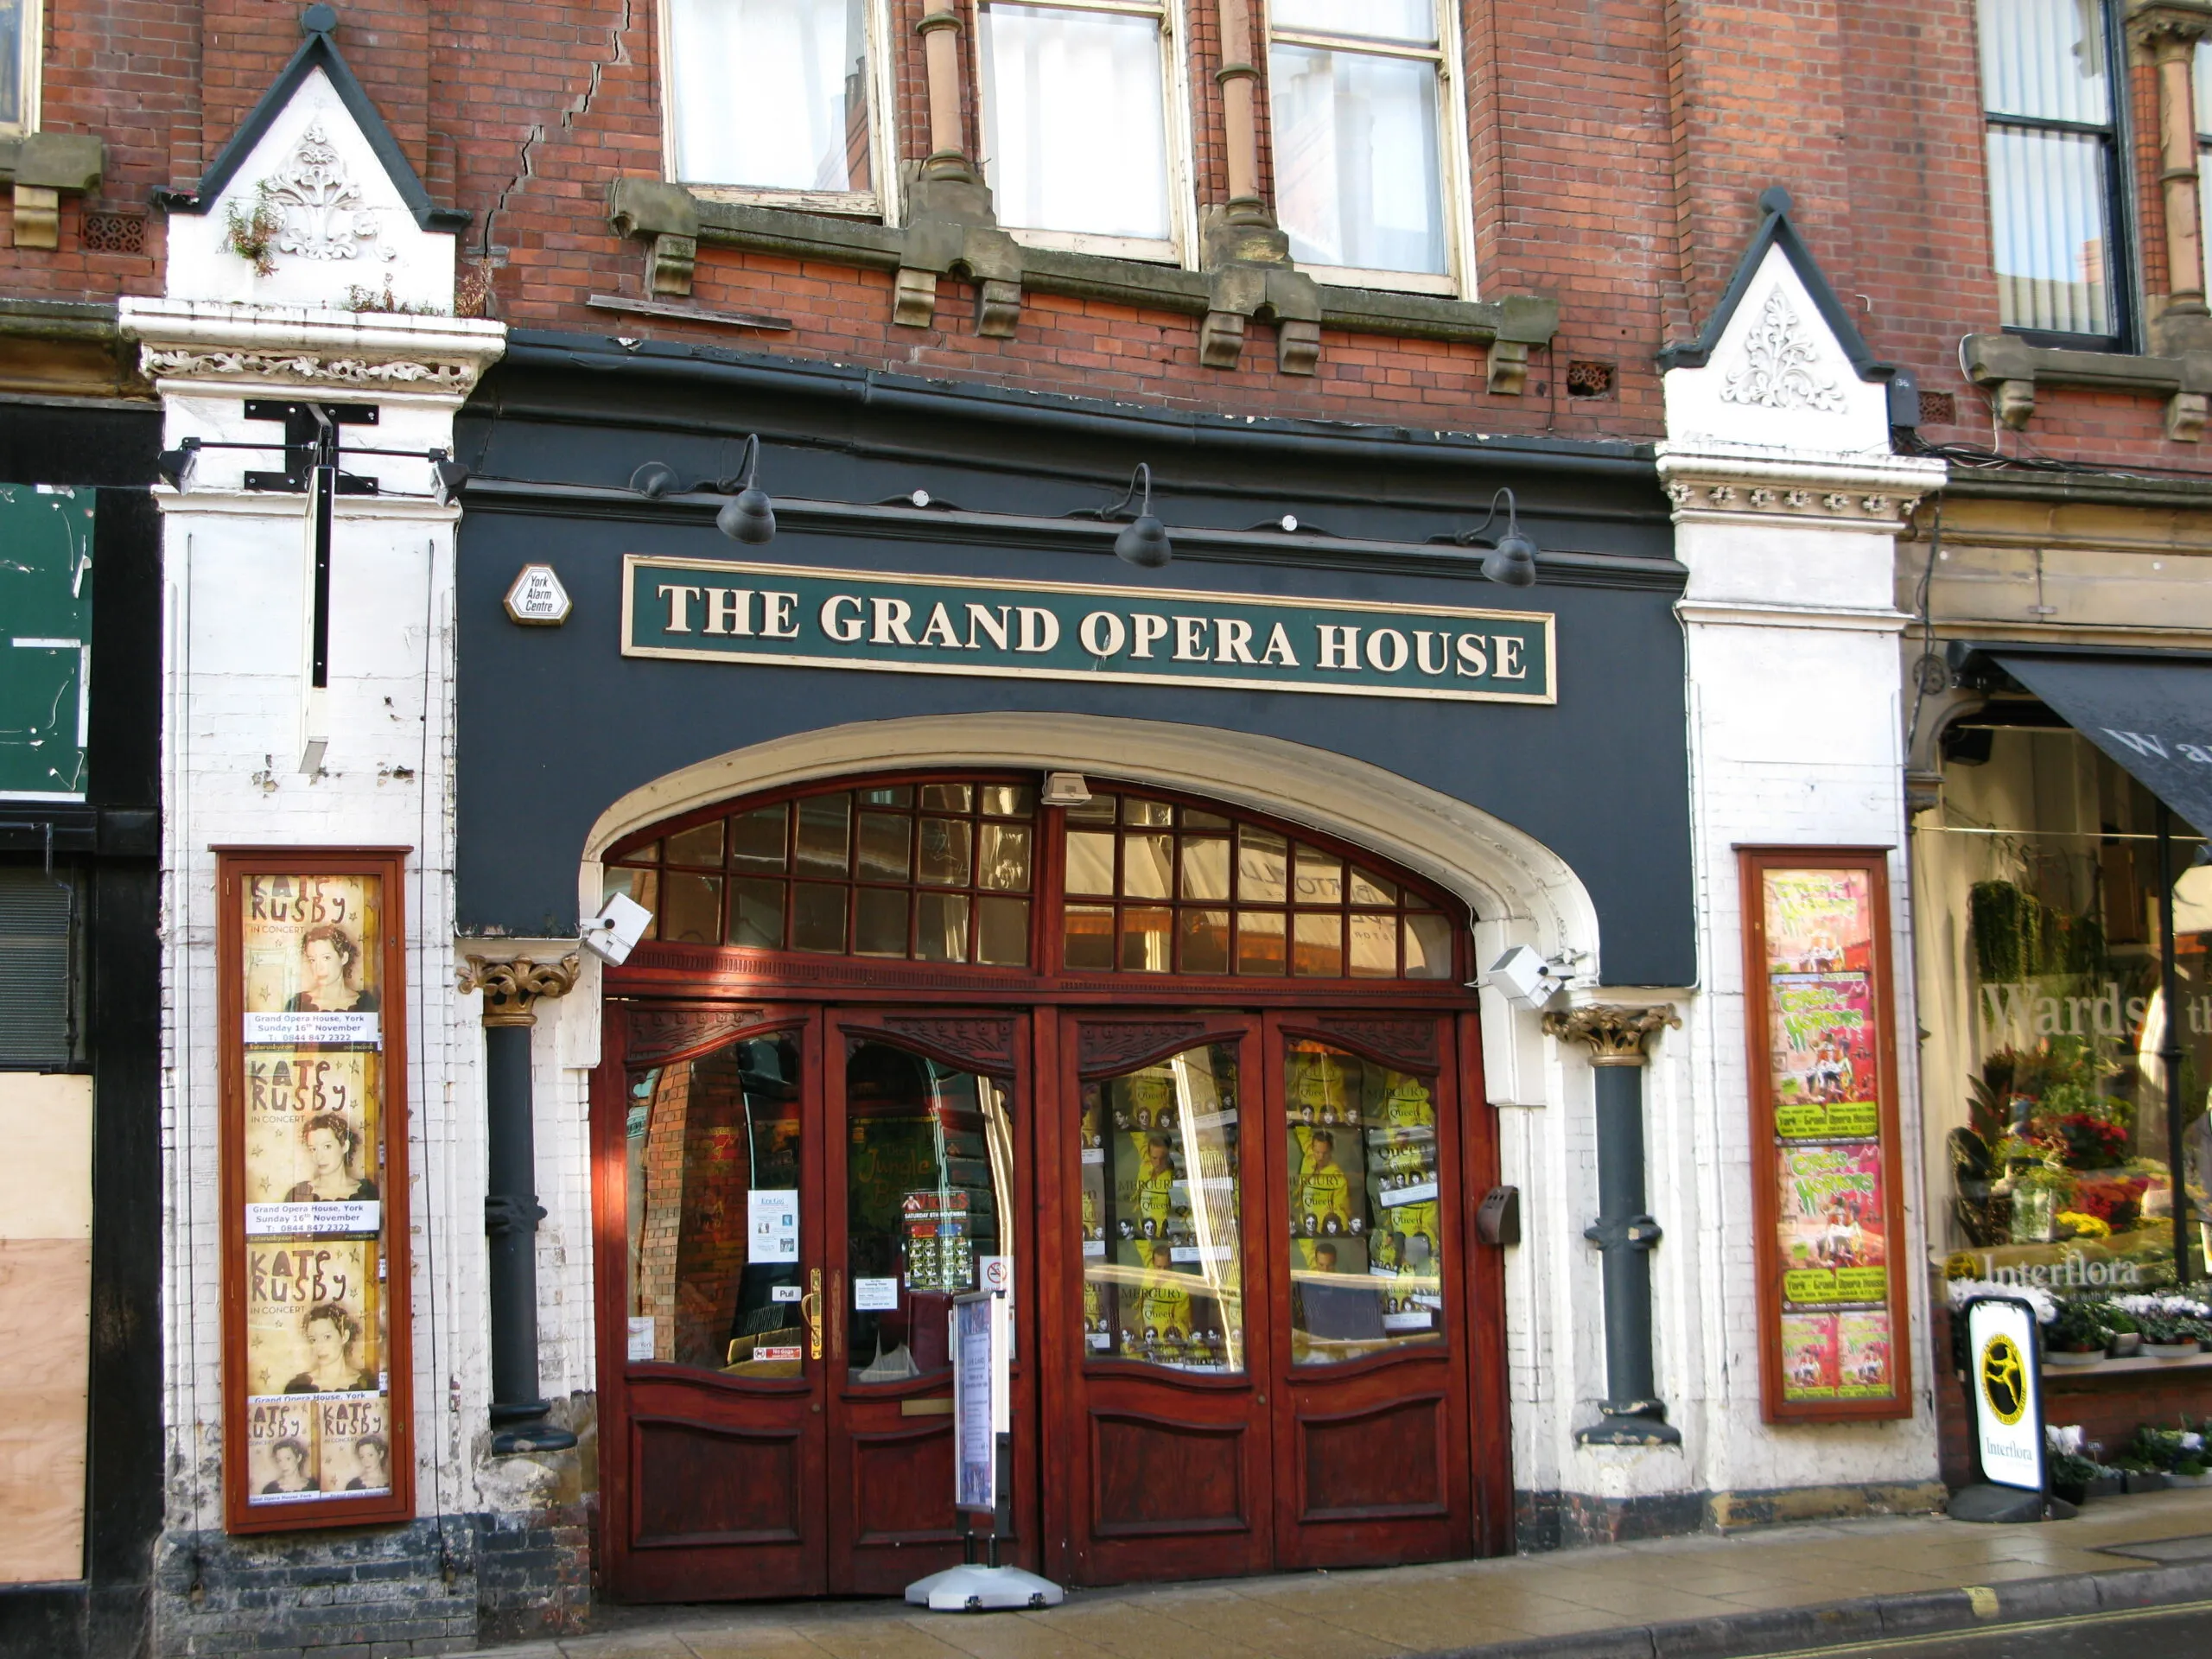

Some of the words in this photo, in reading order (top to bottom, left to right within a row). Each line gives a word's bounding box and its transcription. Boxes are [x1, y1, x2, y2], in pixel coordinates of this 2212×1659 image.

[531, 575, 549, 588] York
[526, 588, 552, 600] Alarm
[525, 601, 553, 612] Centre
[658, 584, 800, 639] THE
[819, 594, 1060, 654] GRAND
[1078, 611, 1300, 667] OPERA
[1316, 624, 1528, 680] HOUSE
[1981, 982, 2147, 1037] Wards
[1366, 1087, 1426, 1099] MERCURY
[262, 1115, 305, 1123] CONCERT
[1389, 1108, 1422, 1121] Queen
[1117, 1179, 1173, 1192] MERCUR
[1141, 1200, 1172, 1212] Queen
[1304, 1194, 1335, 1208] Queen
[1393, 1215, 1422, 1226] Queen
[1981, 1248, 2140, 1287] Interflora
[779, 1289, 795, 1298] Pull
[1122, 1287, 1182, 1299] MERCURY
[262, 1306, 305, 1314] CONCERT
[1144, 1308, 1175, 1319] Queen
[1986, 1436, 2033, 1461] Interflora
